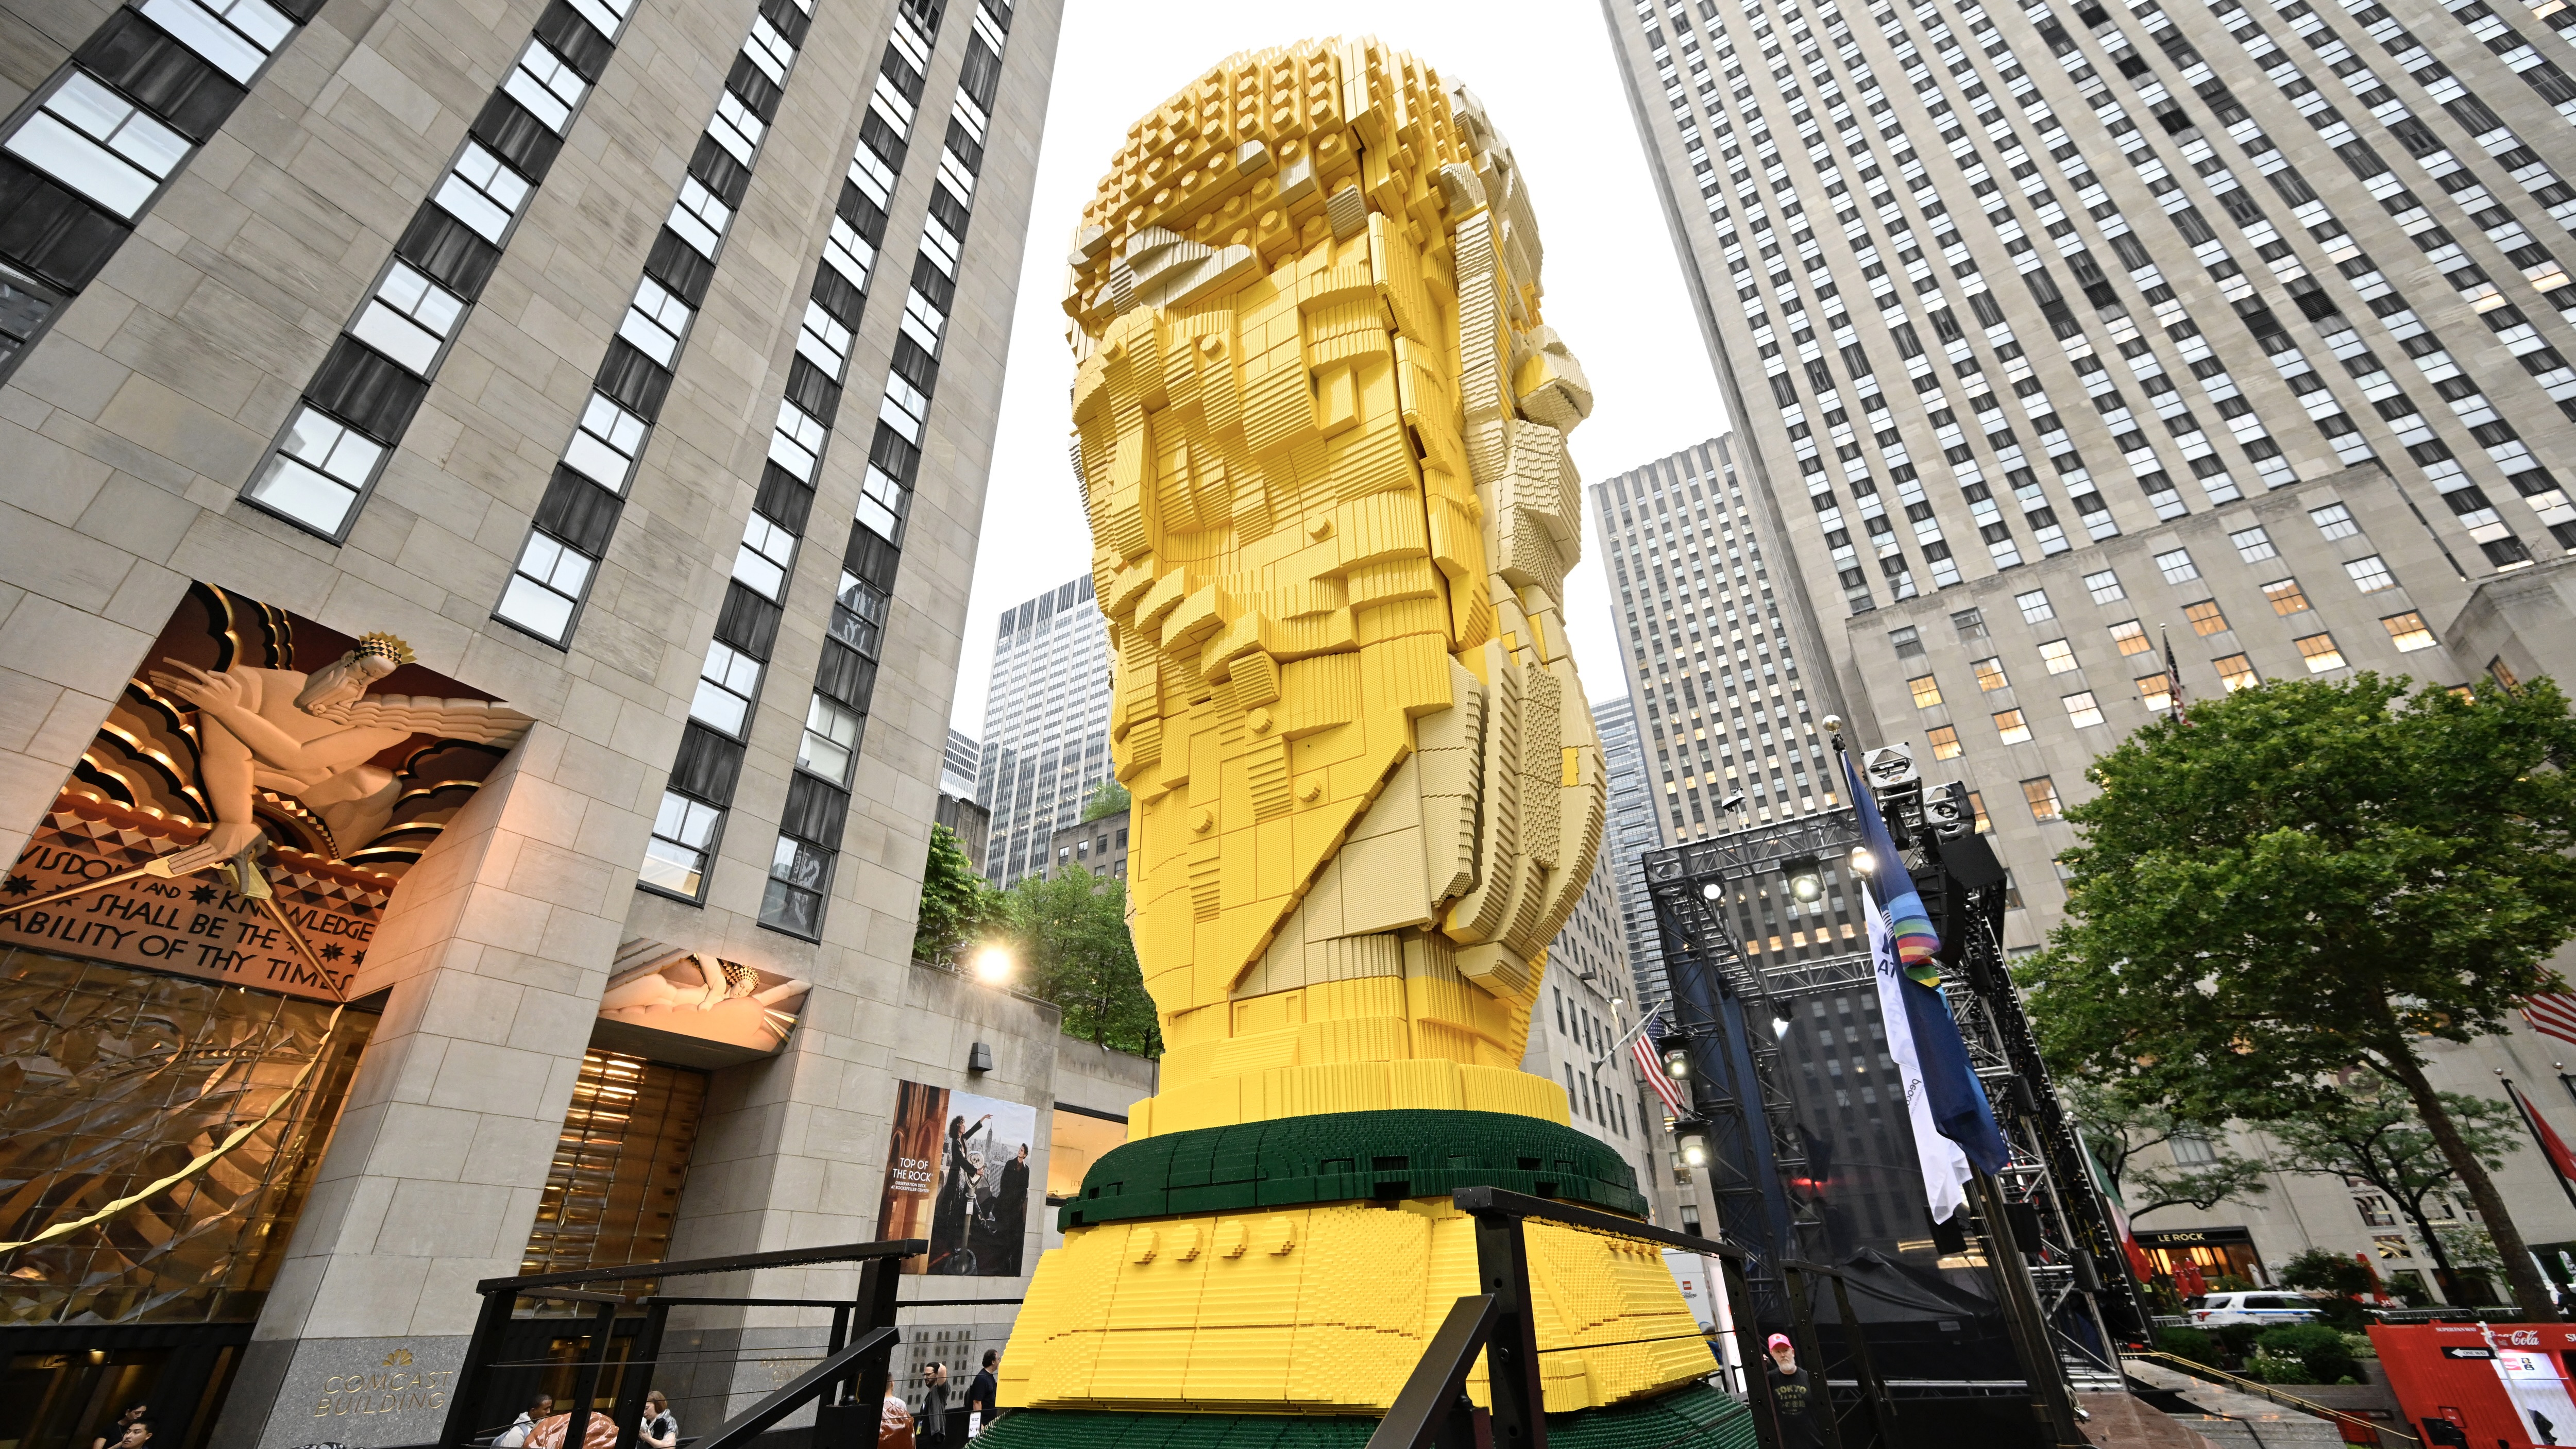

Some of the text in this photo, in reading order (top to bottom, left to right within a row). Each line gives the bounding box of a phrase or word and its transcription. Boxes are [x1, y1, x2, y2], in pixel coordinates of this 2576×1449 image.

[16, 845, 139, 890] ISDO
[142, 882, 181, 899] AND
[86, 894, 281, 950] SHALL BE THE
[139, 935, 189, 959] OF
[197, 943, 258, 973] THY
[267, 957, 354, 990] TIMES
[1906, 1079, 1922, 1106] peaco
[893, 1168, 907, 1179] THE
[900, 1157, 928, 1170] TOP OF
[2172, 1233, 2205, 1241] ROCK
[324, 1371, 453, 1394] COMCAST
[314, 1391, 446, 1417] BUILDING
